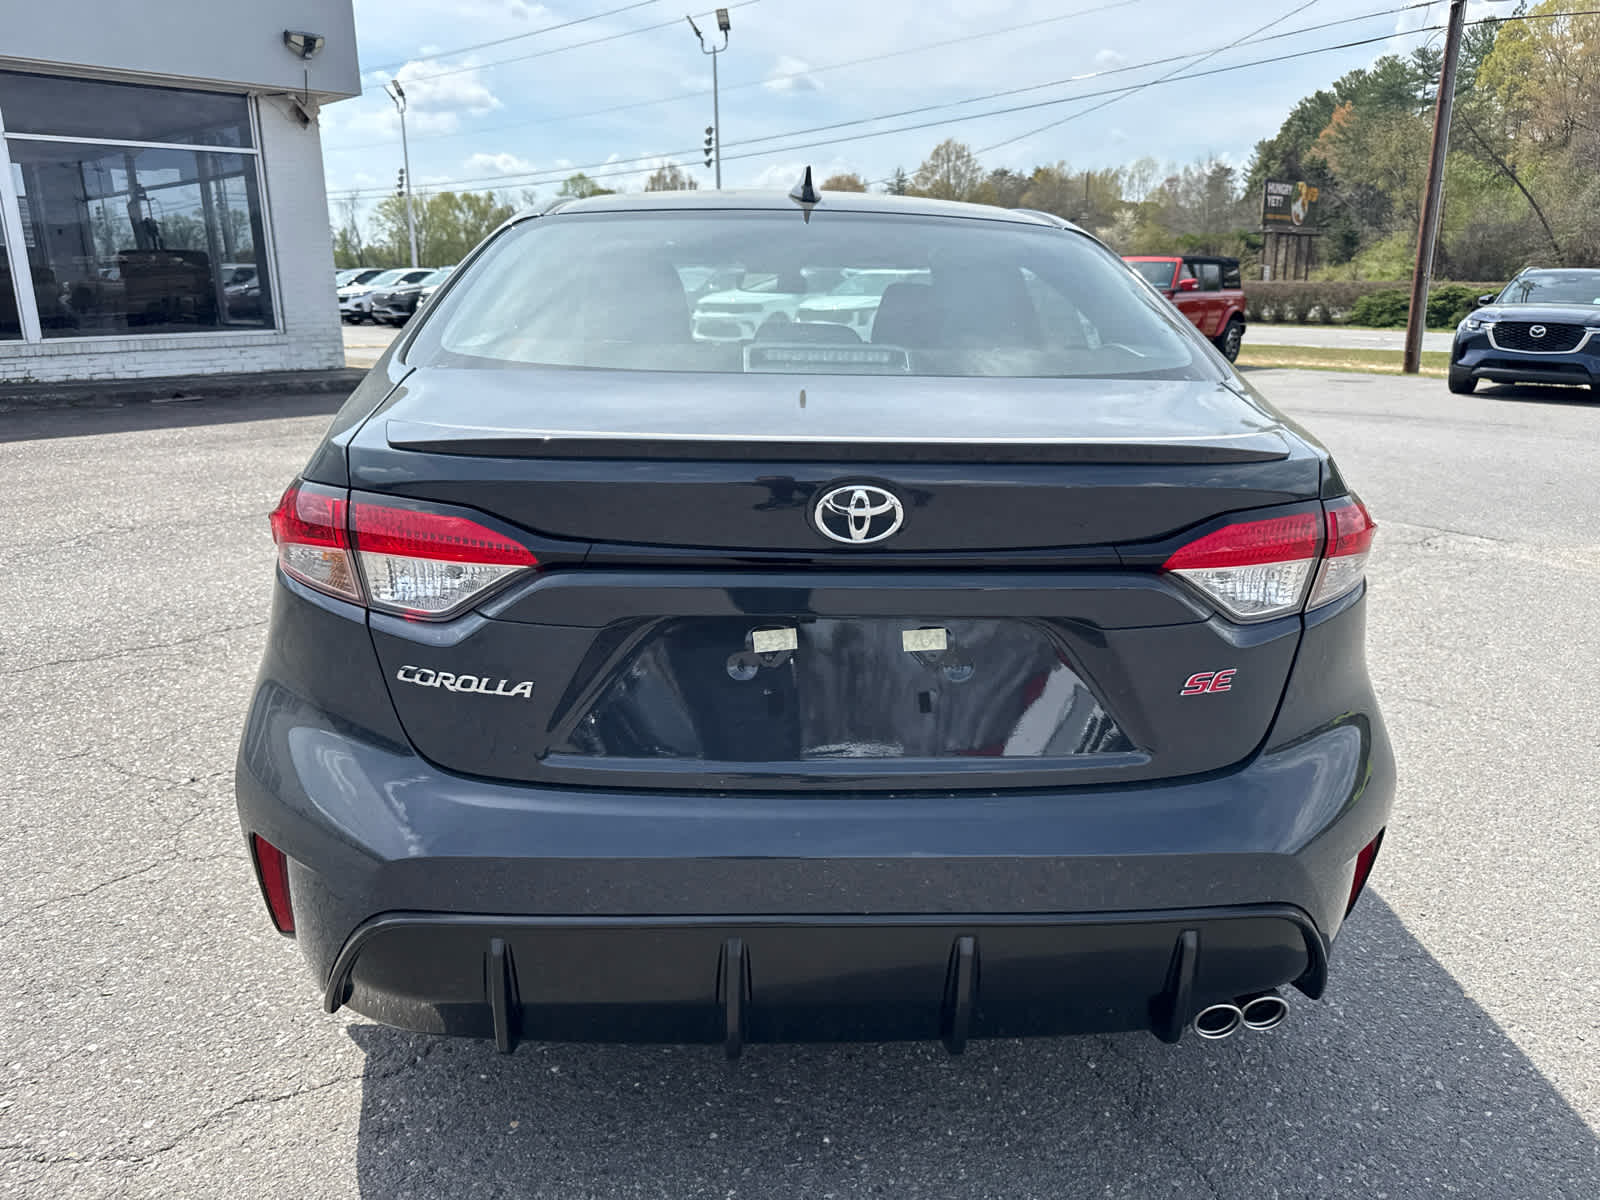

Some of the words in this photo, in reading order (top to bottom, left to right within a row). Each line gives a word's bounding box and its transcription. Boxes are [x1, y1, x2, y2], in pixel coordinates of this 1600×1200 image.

[1267, 182, 1293, 195] HUNGRY
[396, 665, 534, 698] COROLLA
[1180, 668, 1237, 696] SE
